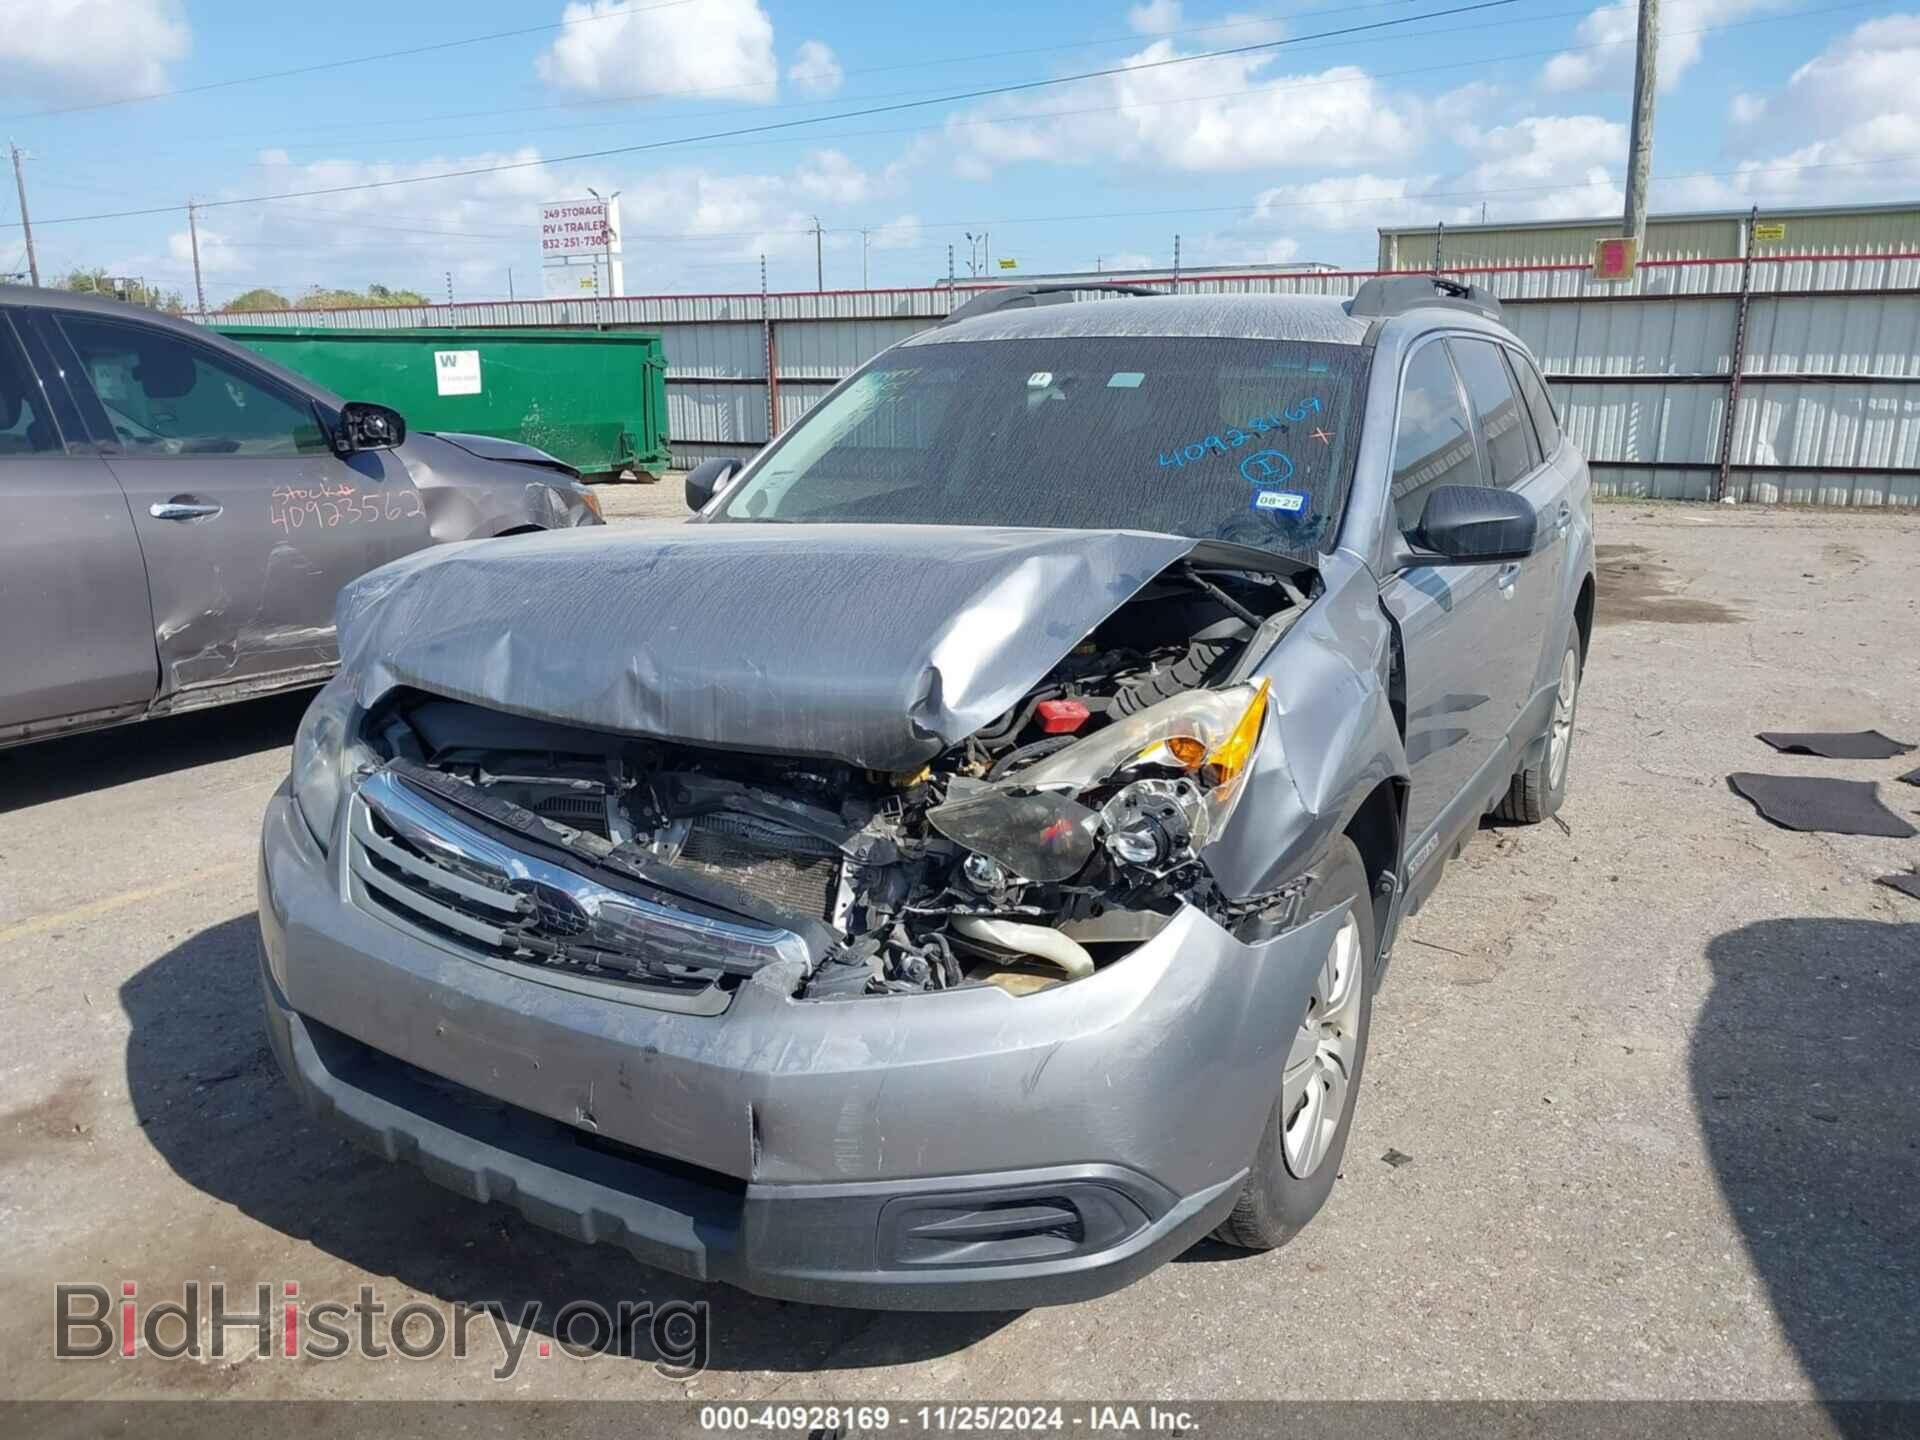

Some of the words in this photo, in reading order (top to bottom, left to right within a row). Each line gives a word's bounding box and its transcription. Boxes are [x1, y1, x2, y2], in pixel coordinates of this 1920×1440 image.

[544, 210, 560, 219] 249
[562, 206, 603, 217] STORAGE
[543, 225, 556, 234] RV
[564, 220, 608, 233] TRAILER
[440, 354, 457, 368] W
[271, 489, 427, 534] 40923562
